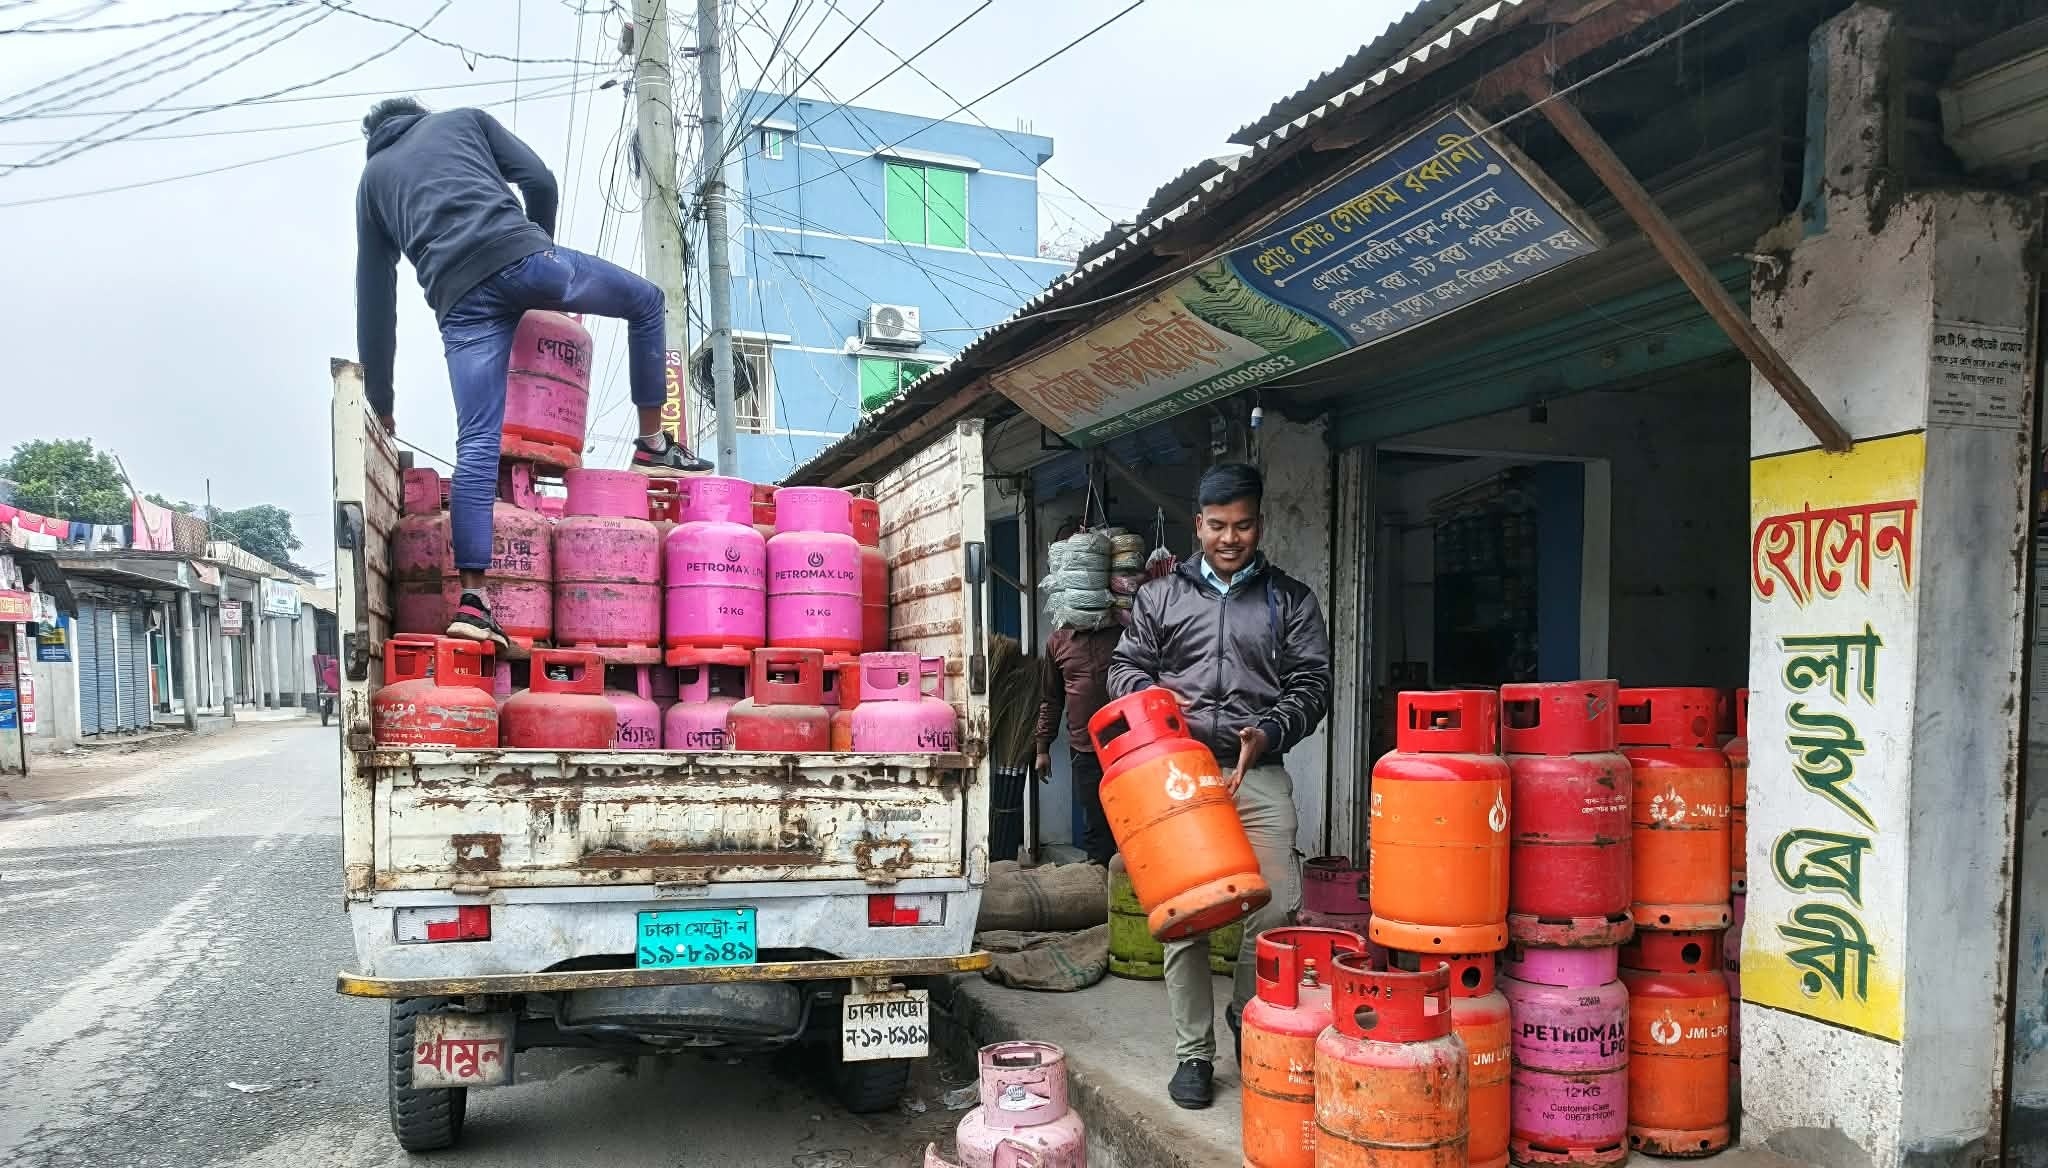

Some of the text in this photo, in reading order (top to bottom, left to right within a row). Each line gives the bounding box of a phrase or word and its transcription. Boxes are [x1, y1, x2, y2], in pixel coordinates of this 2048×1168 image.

[1252, 245, 1296, 276] প্রোঃ
[1291, 222, 1336, 255] মোঃ
[1329, 183, 1406, 233] গোলাম
[1408, 255, 1437, 277] চট
[1432, 242, 1473, 265] বস্তা
[1469, 206, 1545, 250] পাইকারি
[1505, 242, 1553, 266] করা
[1549, 229, 1584, 252] হয়
[1312, 264, 1356, 291] এখানে
[1350, 237, 1406, 271] যাবতীয়
[1182, 354, 1297, 402] 01740008853
[1753, 499, 1919, 603] হোসেন
[686, 562, 749, 575] PETROMAX
[775, 569, 855, 581] PETROMAX LPG
[717, 606, 744, 616] 12 KG
[805, 608, 832, 617] 12 KG
[645, 923, 681, 937] ঢাকা
[641, 942, 753, 965] ১৯-৮৯৪৯
[848, 997, 924, 1023] ঢাকা মেট্রো
[1523, 1023, 1625, 1042] PETROMAX
[1685, 1027, 1708, 1039] JMI
[416, 1032, 505, 1078] থামুন
[1600, 1039, 1625, 1058] LPG
[1473, 1053, 1494, 1066] JMI
[1566, 1086, 1601, 1098] 12 KG
[1550, 1103, 1590, 1113] Customer
